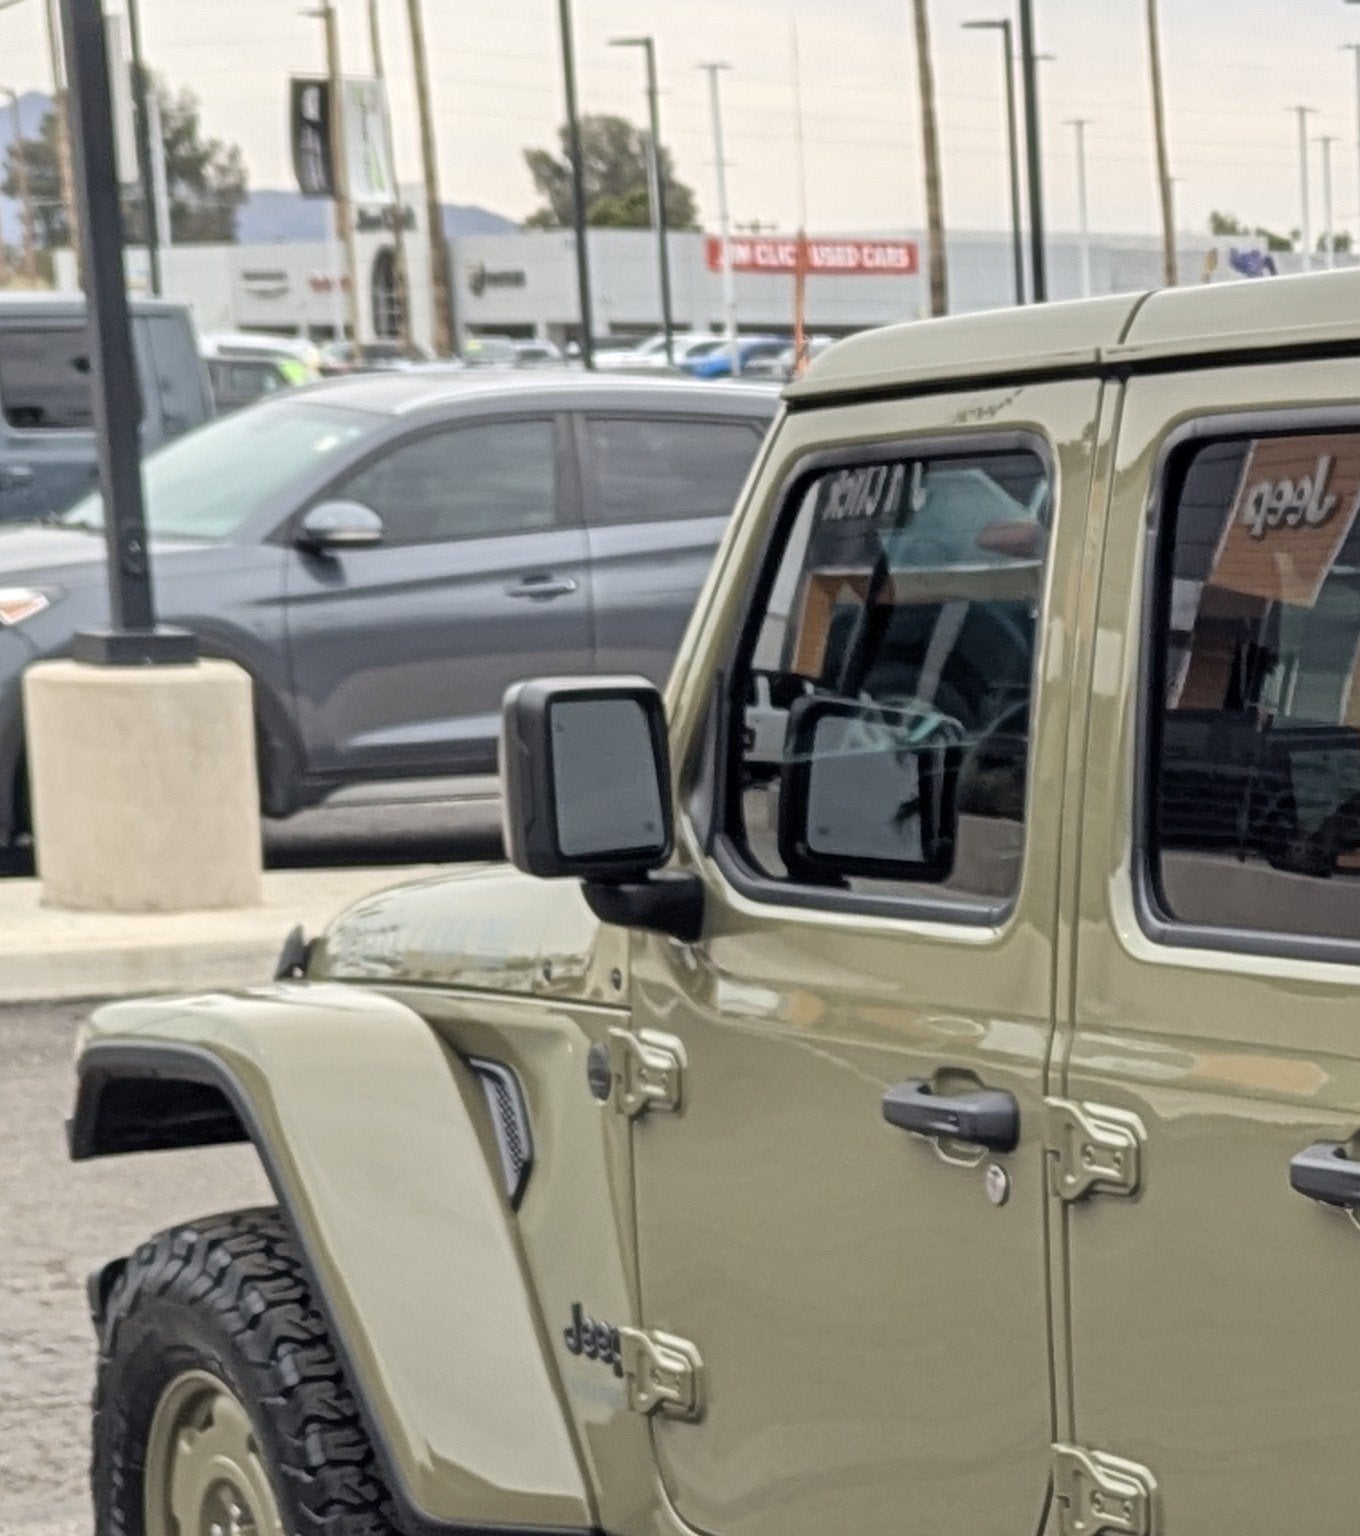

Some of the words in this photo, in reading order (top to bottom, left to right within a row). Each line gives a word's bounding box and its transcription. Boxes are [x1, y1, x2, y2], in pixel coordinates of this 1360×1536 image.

[755, 243, 799, 268] CLIC
[862, 246, 910, 268] CARS
[563, 1301, 623, 1379] Jeep
